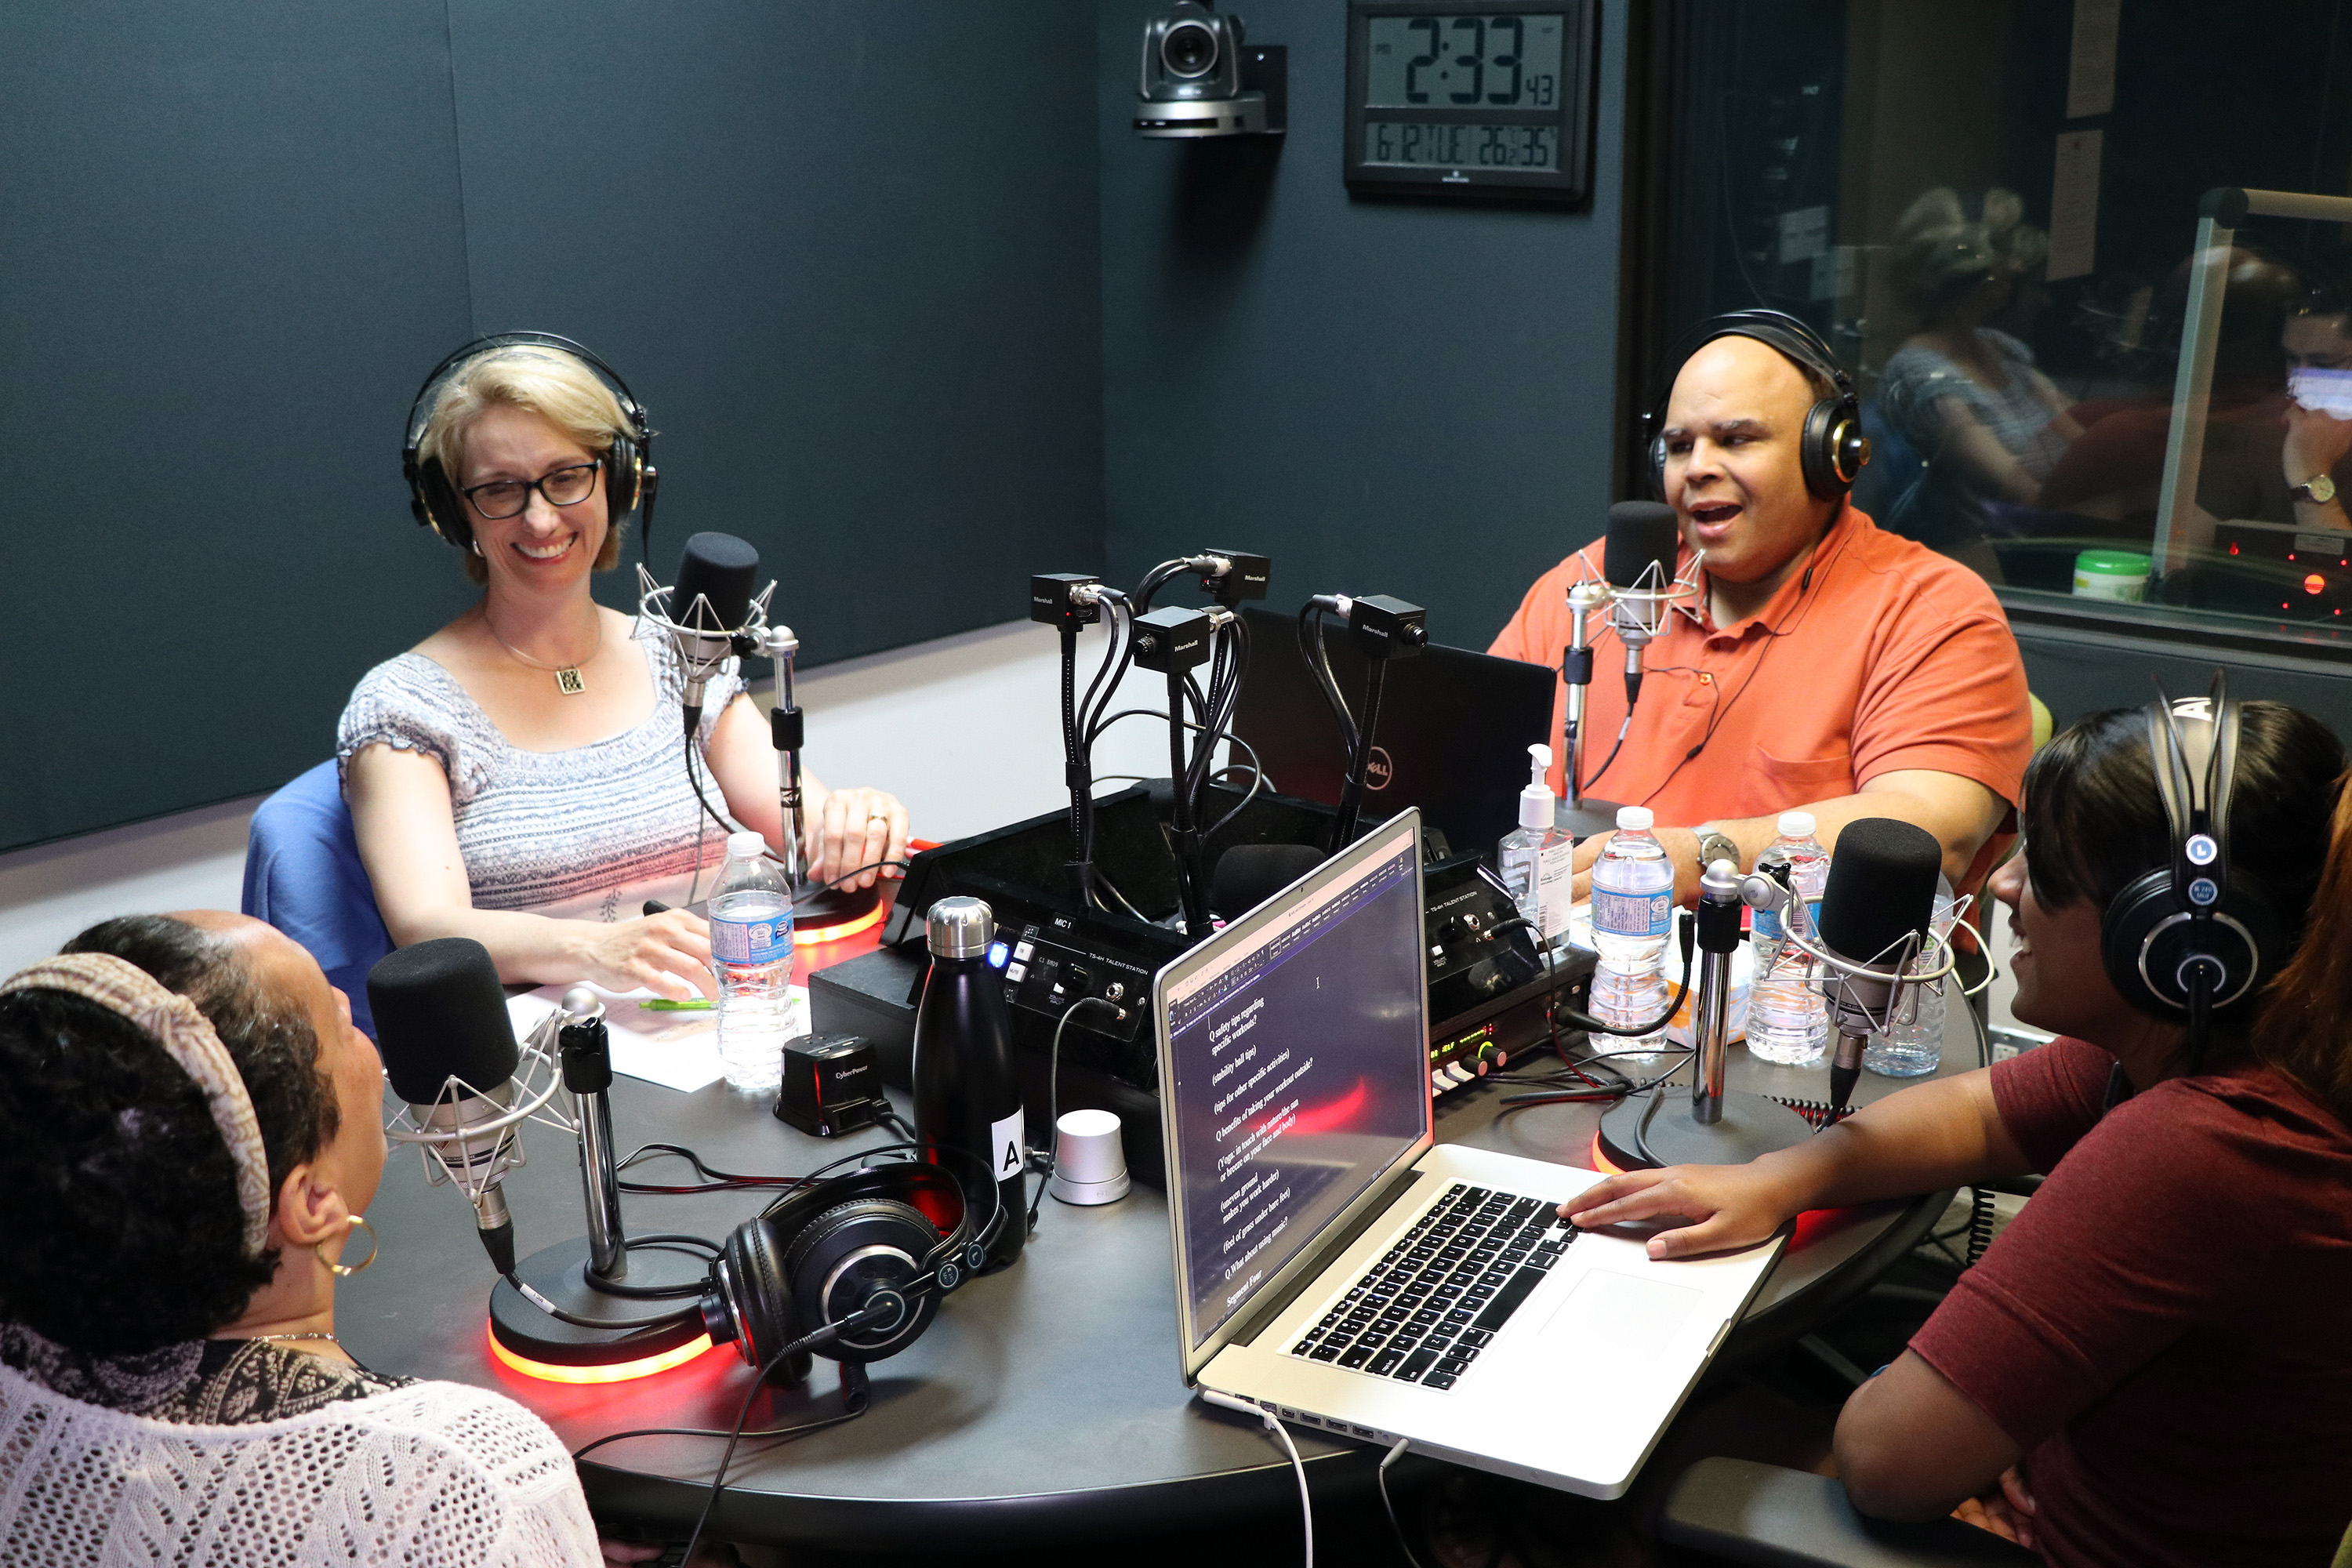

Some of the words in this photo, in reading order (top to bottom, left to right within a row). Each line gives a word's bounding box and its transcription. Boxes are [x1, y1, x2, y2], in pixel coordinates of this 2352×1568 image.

[1406, 17, 1523, 104] 2:33
[1526, 74, 1553, 105] 43
[1033, 596, 1053, 604] Marshall
[1174, 639, 1199, 652] Marshall
[1362, 624, 1388, 638] Marshall
[1367, 762, 1388, 776] ELL
[2197, 844, 2207, 856] L
[1443, 898, 1459, 907] TALENT
[1460, 891, 1477, 901] STATION
[1054, 917, 1067, 928] MIC
[1089, 953, 1105, 961] TS-4H
[1105, 958, 1126, 968] TALENT
[1126, 964, 1149, 975] STATION
[1209, 1030, 1215, 1042] Q
[1215, 1021, 1231, 1038] safety
[1231, 1014, 1241, 1027] tips
[1241, 997, 1265, 1018] regarding
[1211, 1034, 1232, 1057] specific
[1232, 1014, 1258, 1040] workouts?
[836, 1065, 868, 1080] CyberPower
[1212, 1062, 1234, 1087] (stability
[1235, 1052, 1245, 1068] ball
[1245, 1044, 1257, 1061] tips)
[1214, 1099, 1226, 1116] (tips
[1226, 1092, 1235, 1105] for
[1234, 1082, 1247, 1098] other
[1247, 1067, 1267, 1088] specific
[1266, 1047, 1290, 1073] activities)
[1216, 1131, 1221, 1142] Q
[1221, 1116, 1242, 1138] benefits
[1242, 1108, 1248, 1121] of
[1247, 1098, 1264, 1116] taking
[1263, 1089, 1276, 1106] your
[1275, 1073, 1294, 1094] workout
[1294, 1057, 1313, 1079] outside?
[1218, 1150, 1236, 1171] (Yoga:
[1236, 1145, 1242, 1156] in
[1241, 1133, 1256, 1150] touch
[1255, 1123, 1267, 1138] with
[1290, 1098, 1299, 1110] sun
[1220, 1172, 1226, 1182] or
[1226, 1159, 1243, 1177] breeze
[1243, 1152, 1250, 1163] on
[1250, 1142, 1262, 1160] your
[1261, 1134, 1272, 1148] face
[1272, 1124, 1282, 1139] and
[1282, 1112, 1296, 1131] body)
[1003, 1140, 1020, 1172] A
[1221, 1189, 1240, 1213] (uneven
[1240, 1171, 1258, 1196] ground
[1223, 1205, 1239, 1224] makes
[1240, 1196, 1250, 1213] you
[1249, 1184, 1262, 1200] work
[1261, 1168, 1279, 1190] harder)
[1223, 1235, 1236, 1254] (feel
[1235, 1229, 1242, 1242] of
[1241, 1221, 1254, 1239] grass
[1254, 1207, 1269, 1225] under
[1268, 1198, 1279, 1212] bare
[1279, 1186, 1290, 1203] feet)
[1225, 1269, 1231, 1279] Q
[1230, 1257, 1244, 1273] What
[1244, 1244, 1258, 1262] about
[1258, 1232, 1272, 1250] using
[1272, 1216, 1288, 1238] music?
[1226, 1281, 1249, 1308] Segment
[1249, 1269, 1262, 1287] Four
